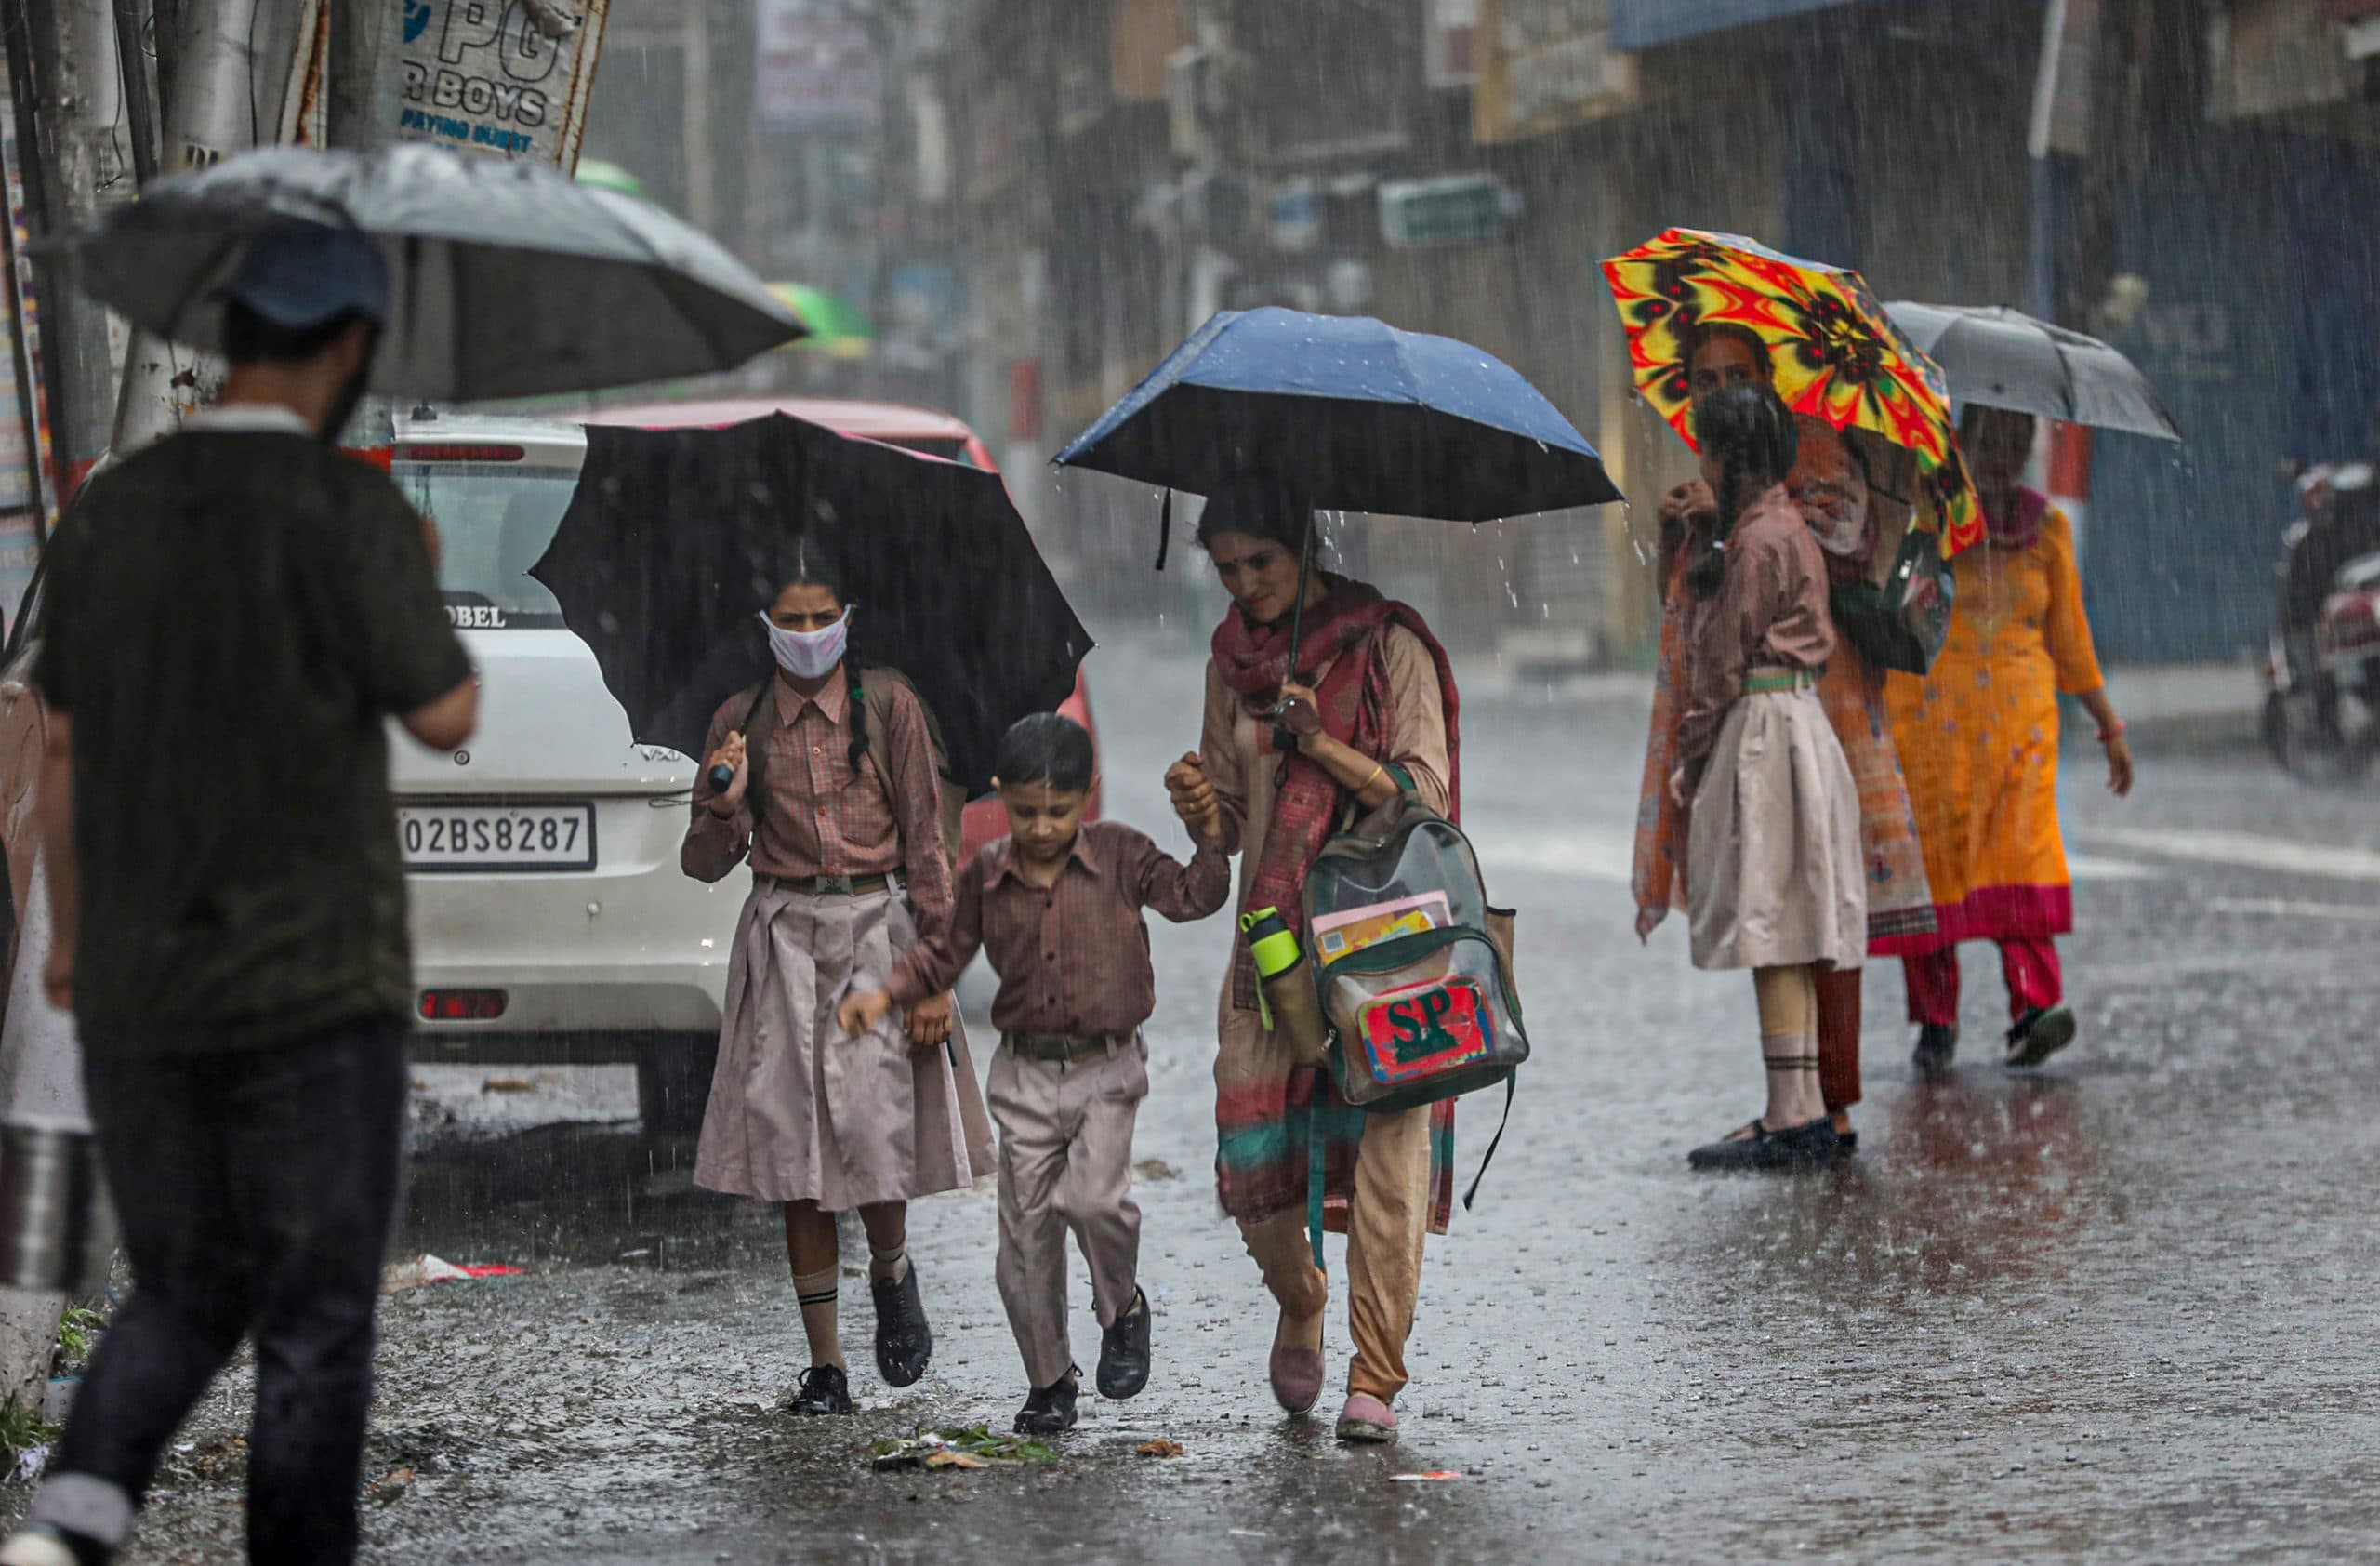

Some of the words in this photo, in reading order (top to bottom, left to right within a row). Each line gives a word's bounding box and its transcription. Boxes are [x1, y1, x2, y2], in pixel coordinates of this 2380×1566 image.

[439, 0, 561, 82] PG
[432, 68, 549, 127] BOYS
[405, 817, 580, 853] 02BS8287
[1388, 989, 1452, 1046] SP
